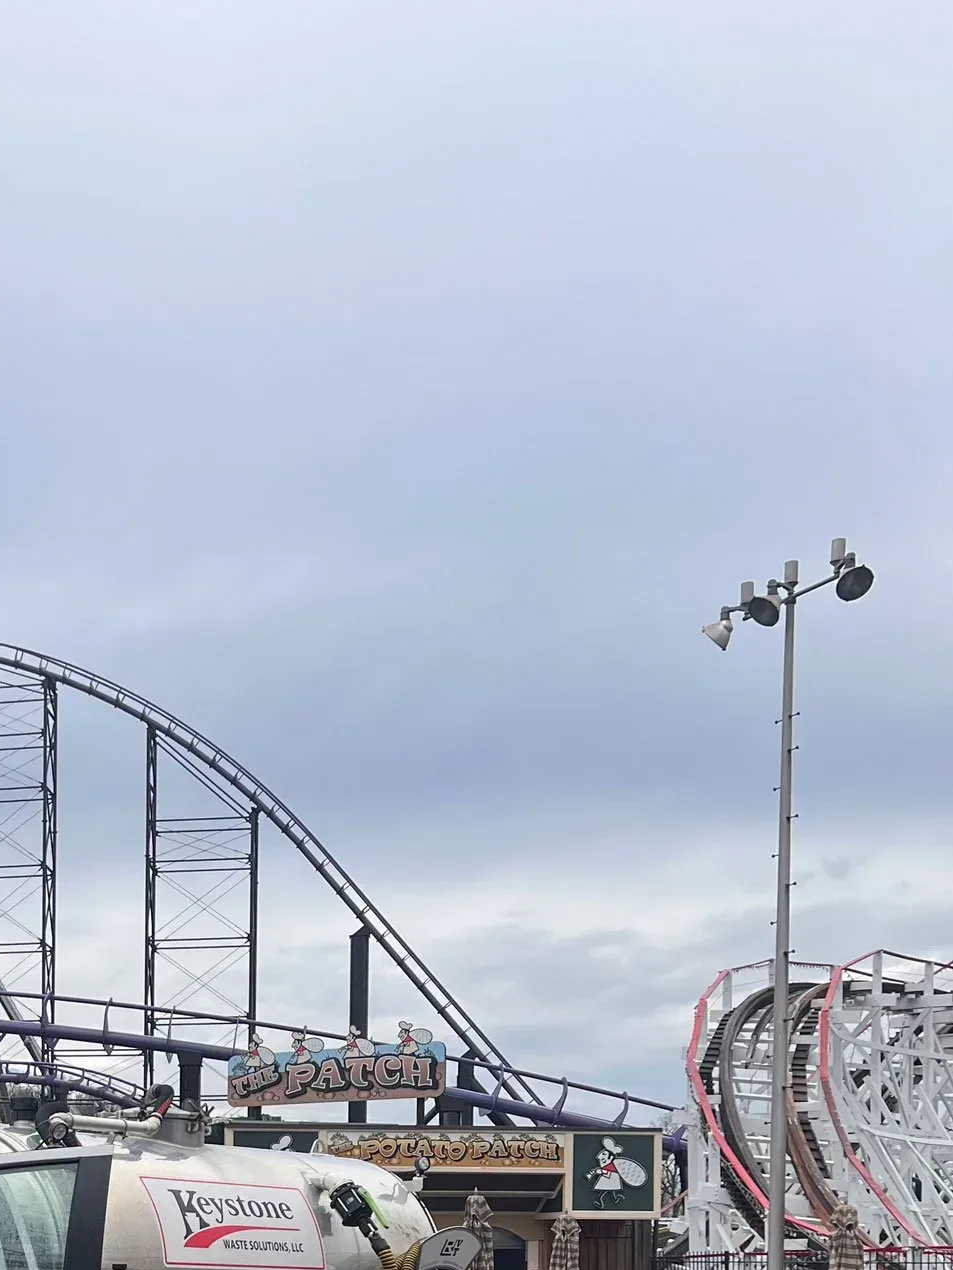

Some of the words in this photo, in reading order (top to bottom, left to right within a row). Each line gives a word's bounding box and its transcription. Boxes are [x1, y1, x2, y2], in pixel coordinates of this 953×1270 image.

[231, 1065, 279, 1095] THE
[285, 1054, 435, 1096] PATCH
[358, 1137, 467, 1161] POTATO
[471, 1138, 560, 1160] PATCH
[167, 1188, 294, 1240] Keystone
[223, 1239, 248, 1251] WASTE
[249, 1240, 291, 1253] SOLUTIONS,
[292, 1242, 305, 1253] LLC
